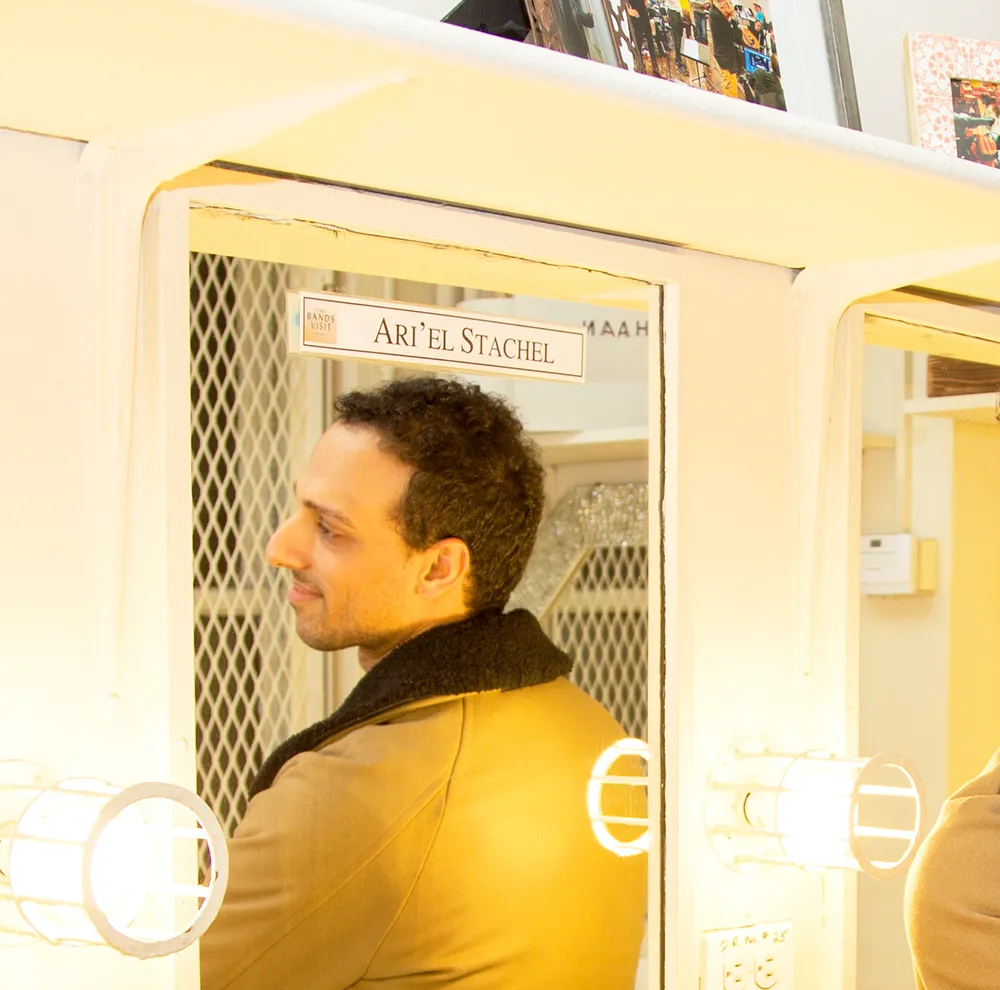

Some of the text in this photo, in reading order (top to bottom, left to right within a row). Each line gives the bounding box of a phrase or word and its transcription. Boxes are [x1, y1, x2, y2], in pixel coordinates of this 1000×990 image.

[306, 311, 335, 323] BAND'S
[310, 320, 331, 331] VISIT
[373, 317, 555, 364] ARI'EL STACHEL
